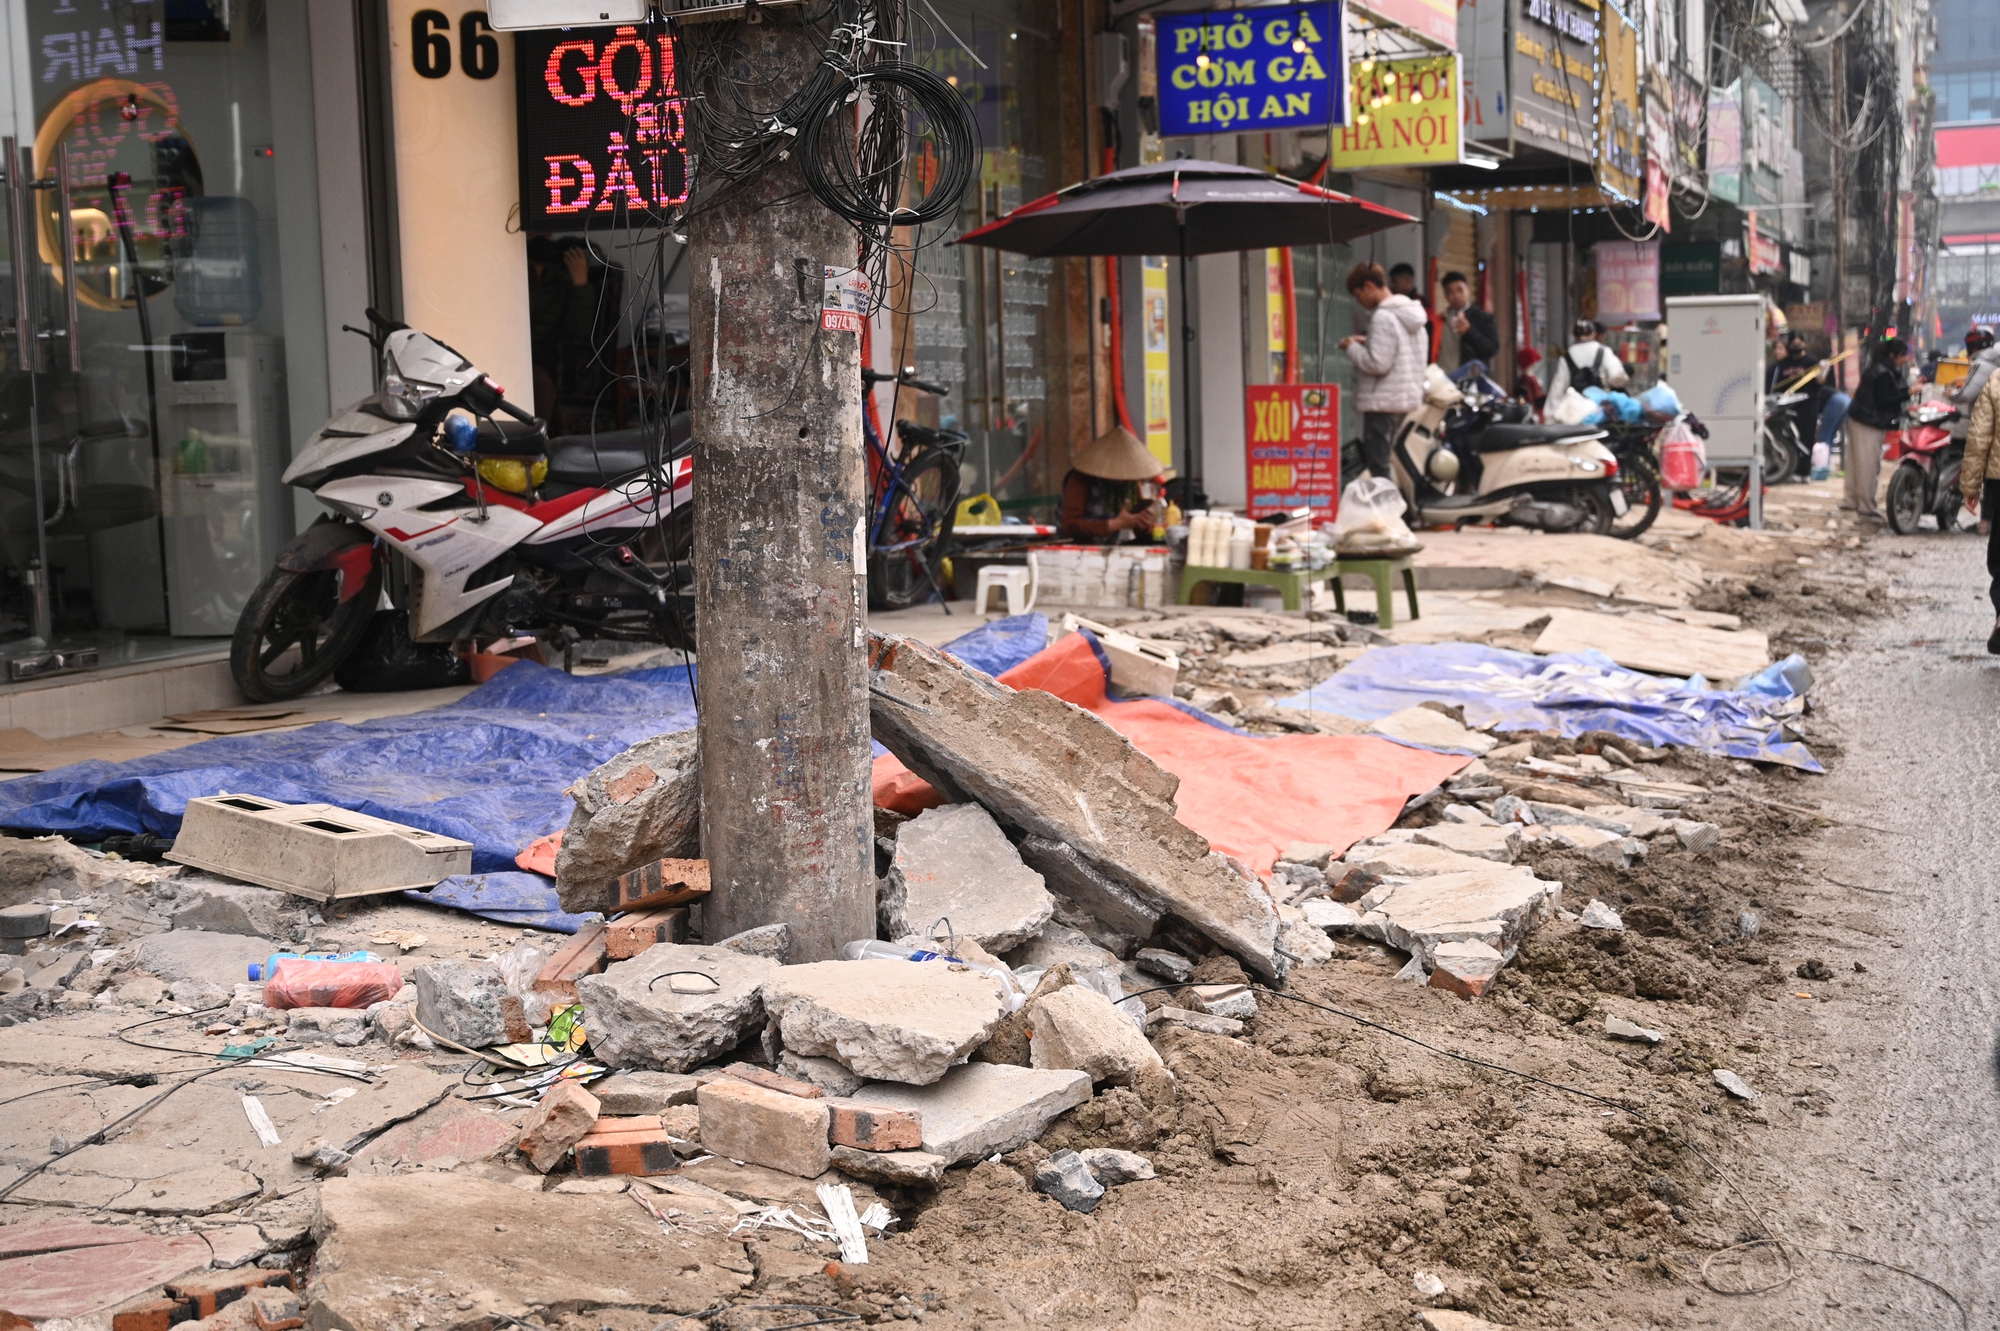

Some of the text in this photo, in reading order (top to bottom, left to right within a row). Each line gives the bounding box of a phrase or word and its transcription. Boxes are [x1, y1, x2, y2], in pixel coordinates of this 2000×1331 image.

[411, 9, 499, 79] 66
[1174, 11, 1322, 53] PHỞ GÀ
[1171, 47, 1326, 90] CƠM GÀ
[1187, 92, 1312, 128] HỘI AN
[1341, 108, 1449, 154] HÀ NỘI
[1253, 391, 1290, 442] XÔI
[1252, 460, 1292, 490] BÁNH
